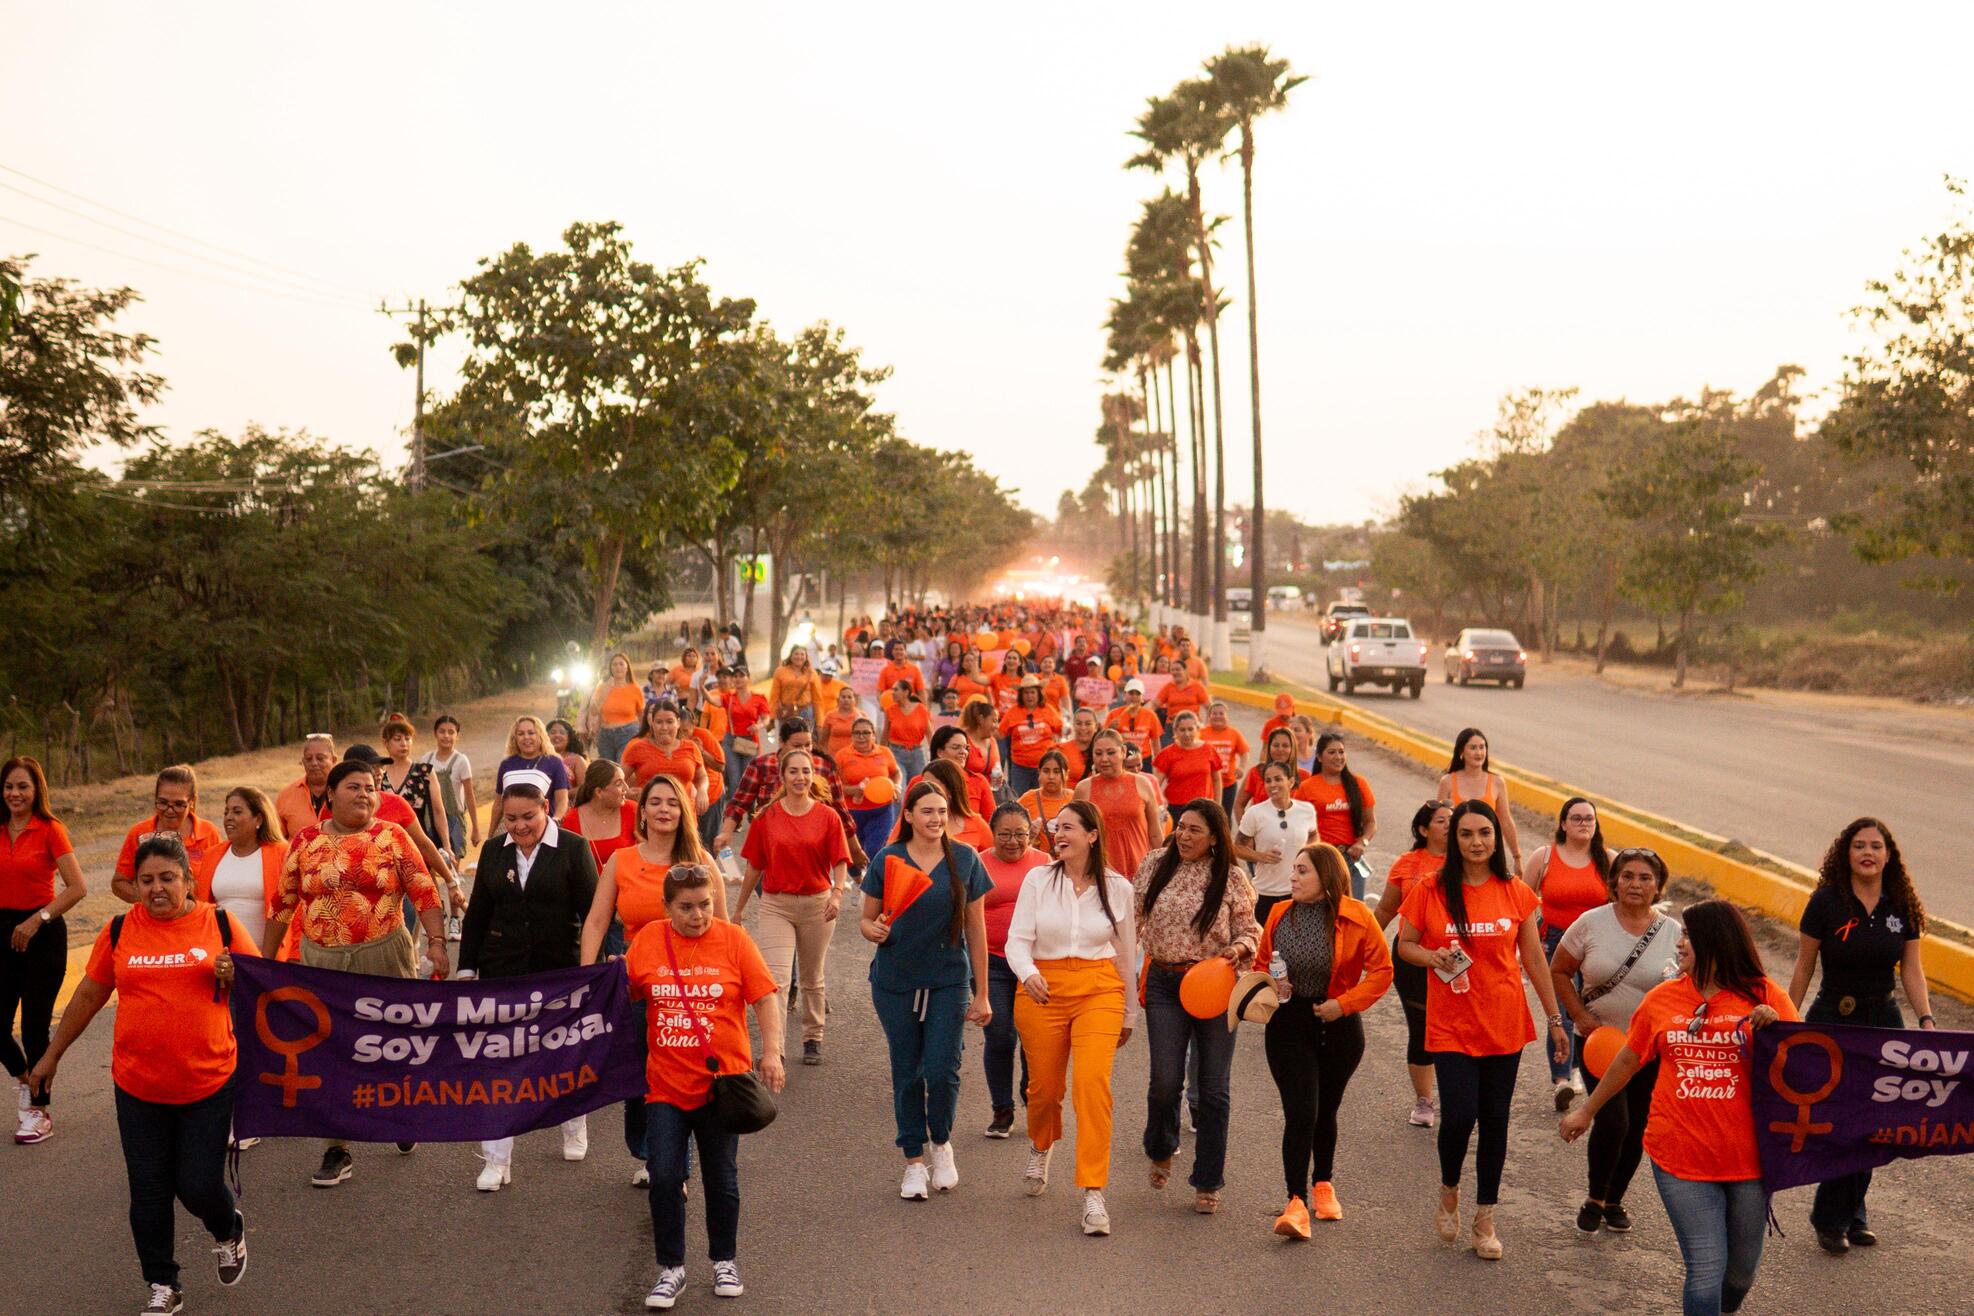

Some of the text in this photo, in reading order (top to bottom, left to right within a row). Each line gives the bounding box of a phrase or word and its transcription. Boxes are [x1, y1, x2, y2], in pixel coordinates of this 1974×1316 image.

[128, 953, 186, 965] MUJER
[651, 983, 708, 997] BRILLAS
[353, 996, 443, 1029] Soy
[666, 1014, 708, 1029] eligs
[352, 1012, 613, 1066] Soy Valiosa.
[1666, 1030, 1730, 1044] BRILLAS
[1673, 1046, 1739, 1063] CUANDO
[1878, 1039, 1970, 1077] Soy
[1686, 1064, 1732, 1080] eliges
[352, 1063, 600, 1109] #DÍANARANJA
[1675, 1077, 1737, 1100] Sanar
[1870, 1075, 1961, 1108] Soy
